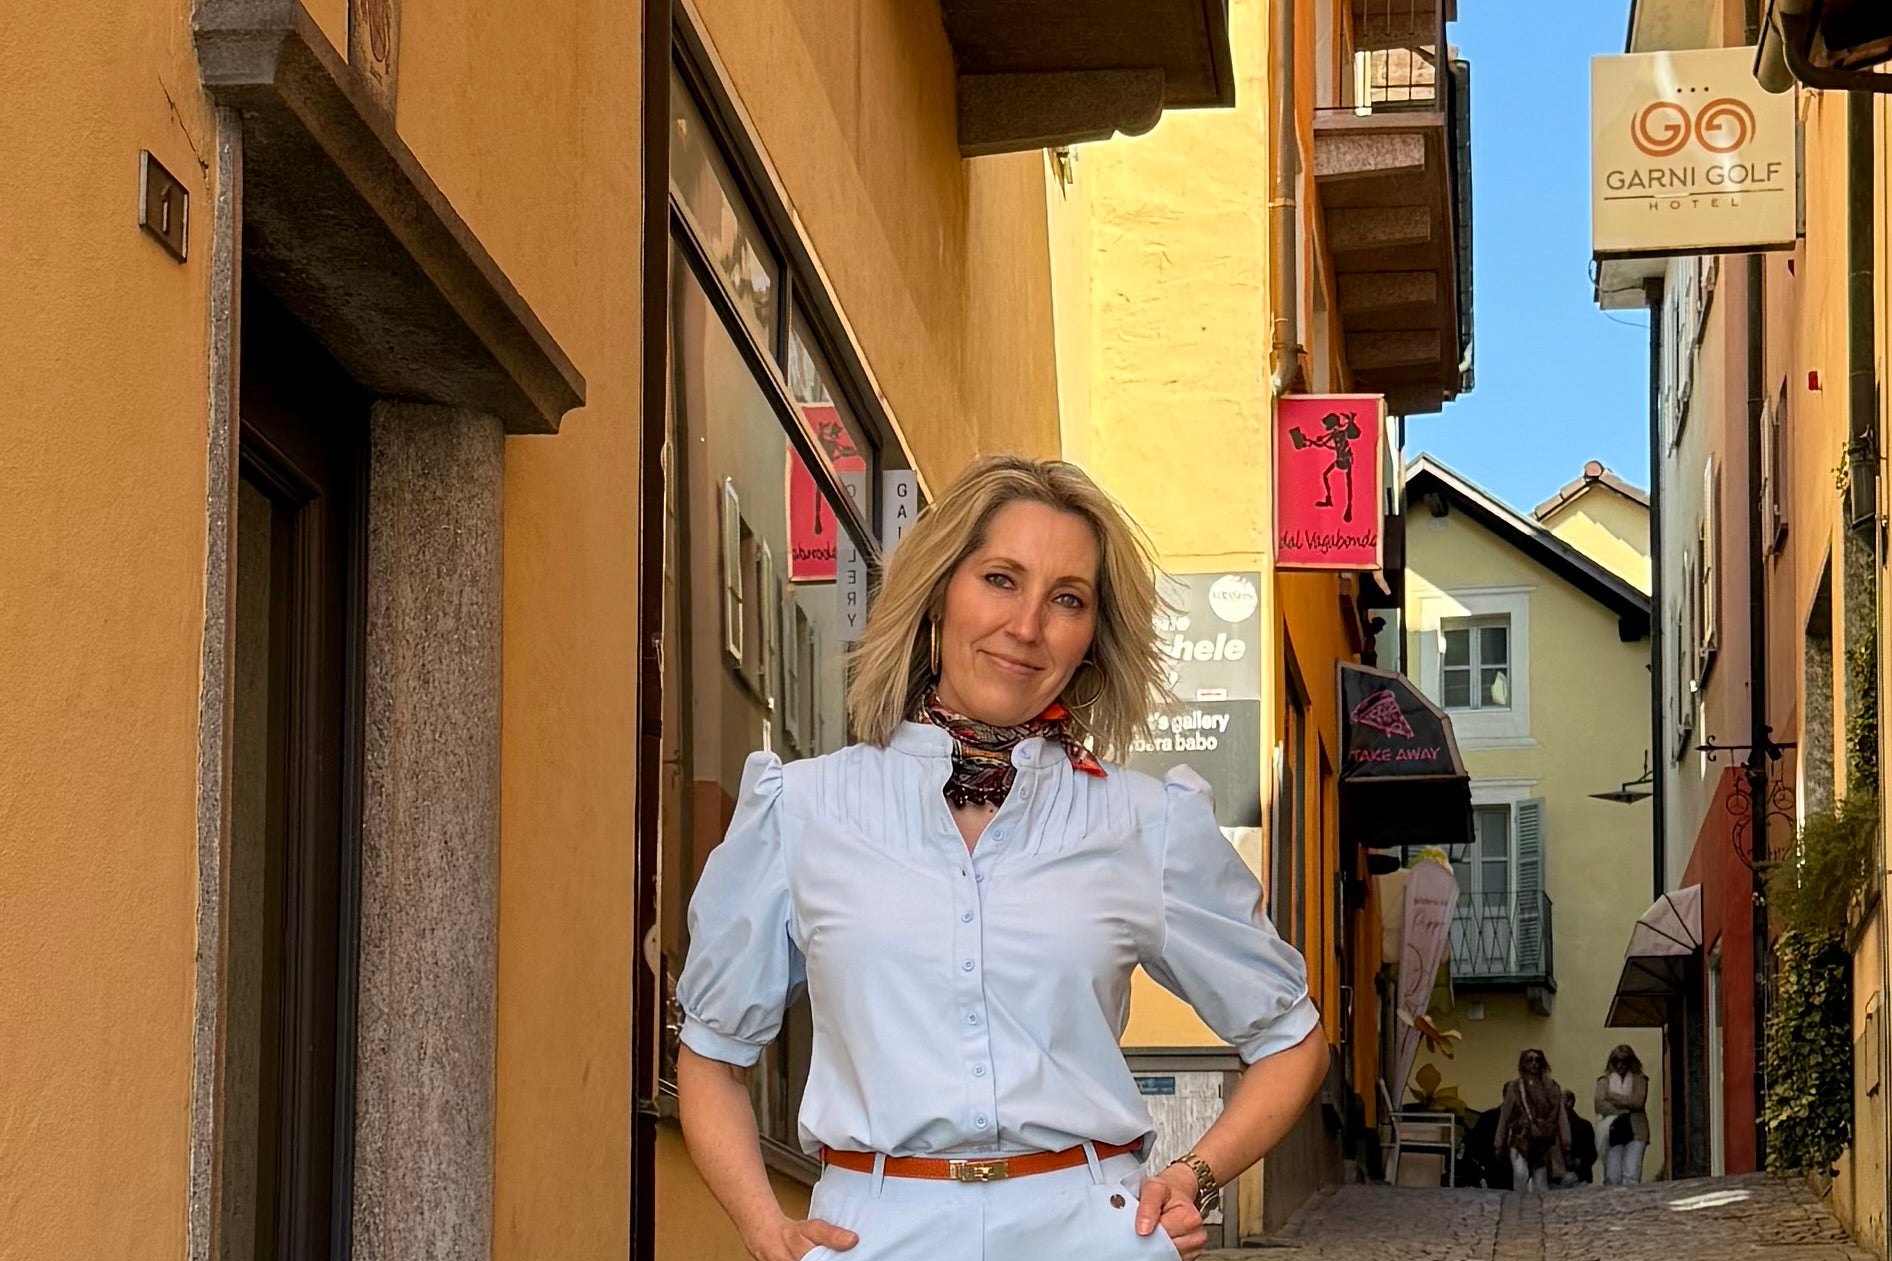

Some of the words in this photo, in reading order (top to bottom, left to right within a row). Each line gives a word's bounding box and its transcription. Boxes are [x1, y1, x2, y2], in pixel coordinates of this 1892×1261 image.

[1606, 166, 1695, 190] GARNI
[1706, 162, 1782, 185] GOLF
[1649, 197, 1738, 211] HOTEL
[1171, 633, 1246, 661] hele
[1171, 710, 1230, 732] gallery
[1175, 731, 1218, 751] babo
[1350, 748, 1391, 762] TAKE
[1396, 747, 1440, 760] AWAY
